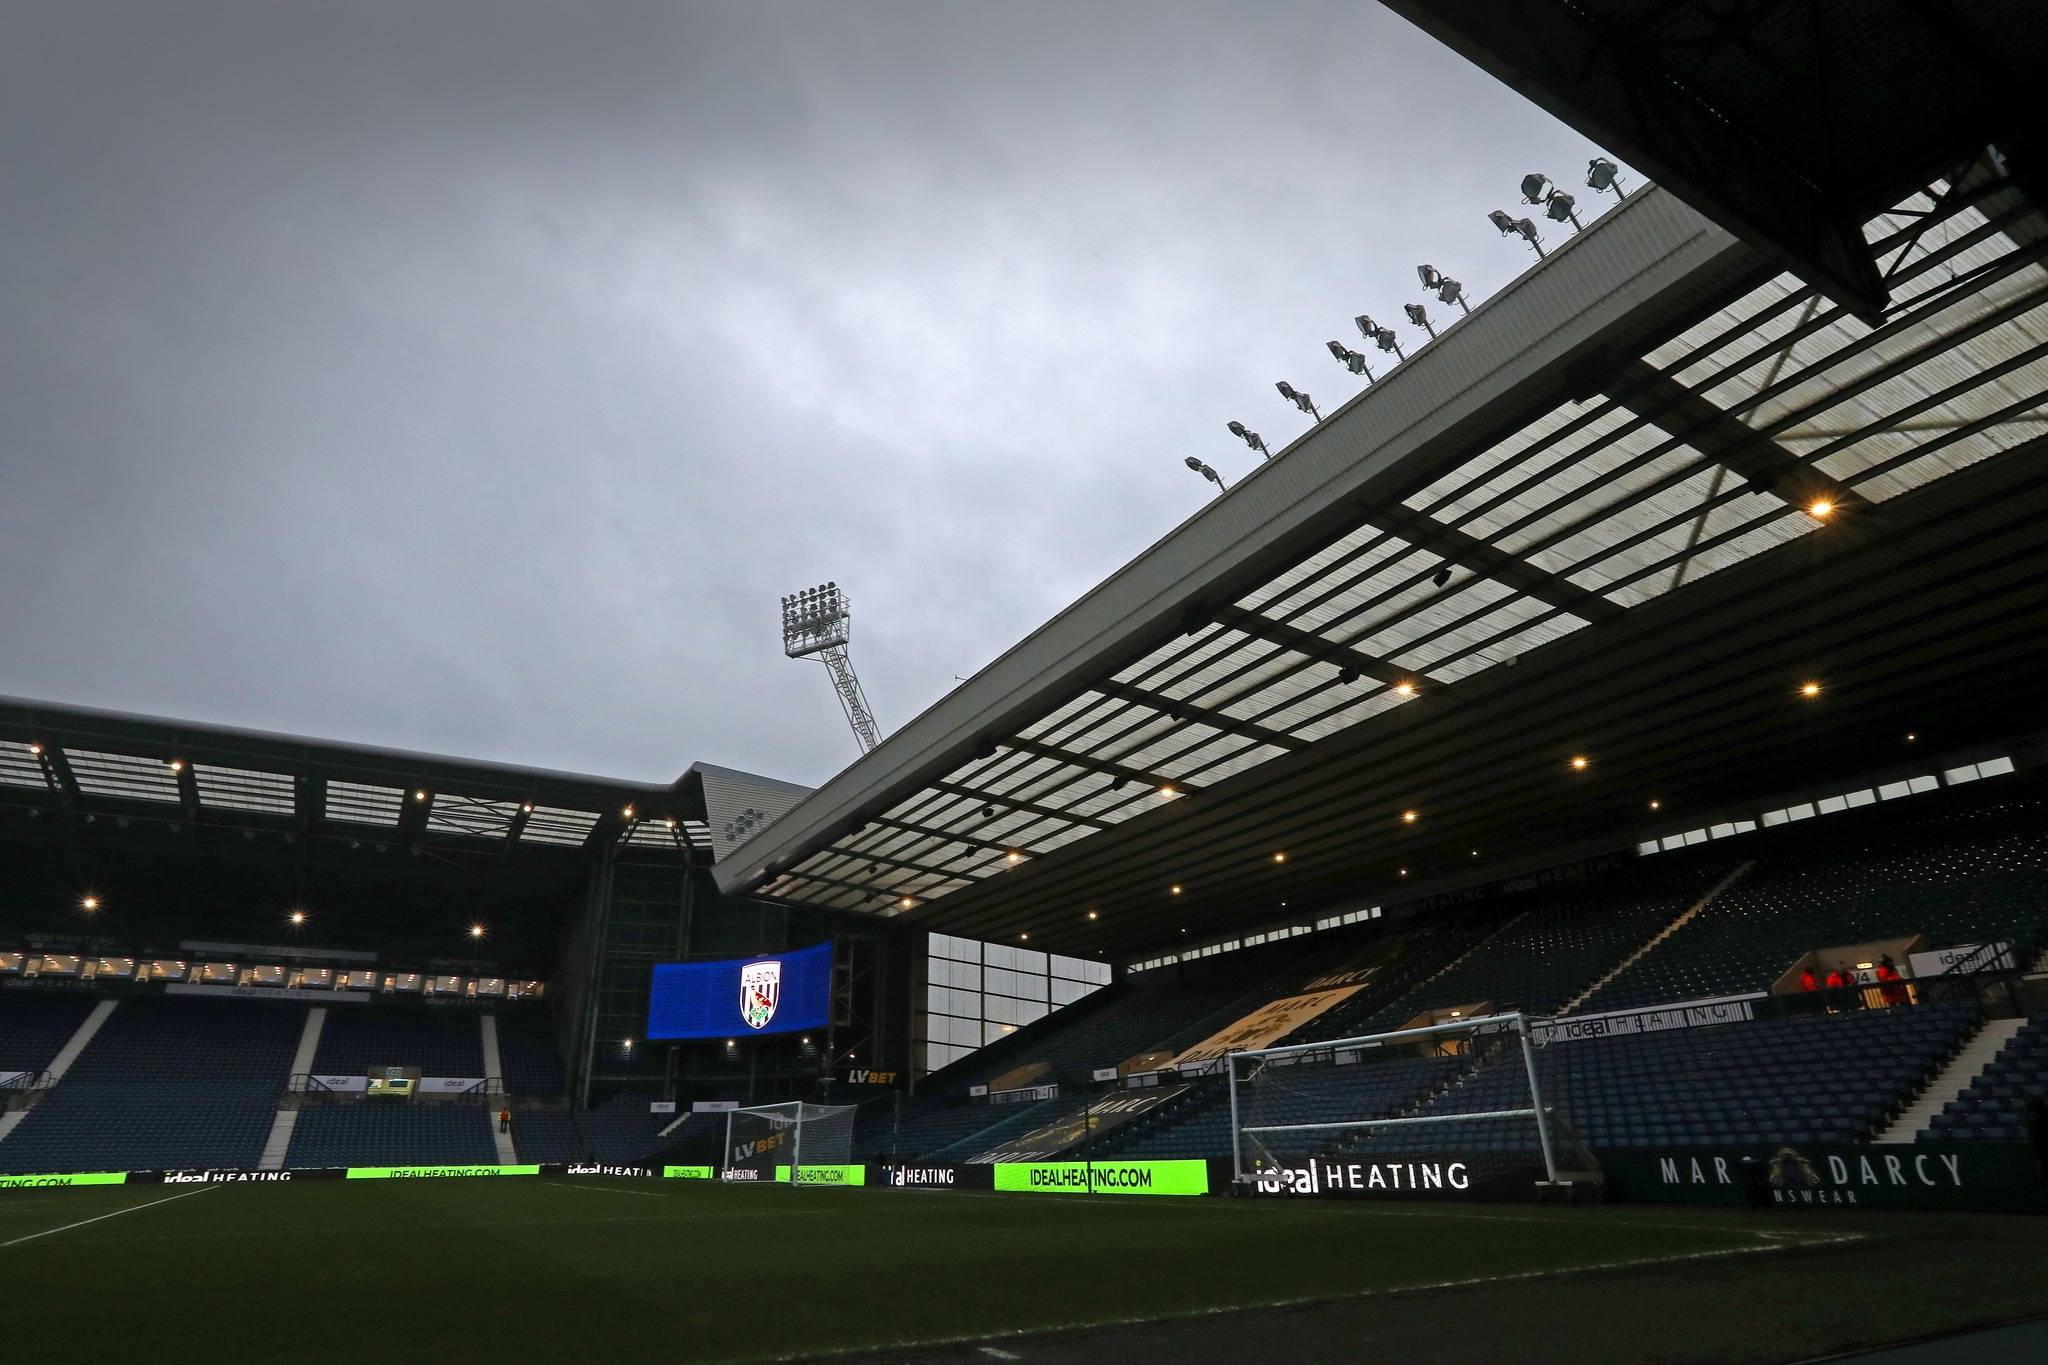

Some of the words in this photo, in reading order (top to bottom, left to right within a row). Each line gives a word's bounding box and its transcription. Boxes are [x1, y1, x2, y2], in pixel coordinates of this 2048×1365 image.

[745, 971, 777, 984] ALBION
[326, 1078, 349, 1086] ideal
[443, 1079, 465, 1088] ideal
[212, 1171, 292, 1182] HEATING
[389, 1168, 501, 1180] IDEALHEATING.COM
[796, 1169, 845, 1183] EALHEATING.COM
[906, 1168, 955, 1185] HEATING
[1326, 1162, 1470, 1190] HEATING
[1660, 1156, 1733, 1185] MAR
[1827, 1154, 1962, 1187] DARCY
[1030, 1168, 1152, 1188] IDEALHEATING.COM
[1772, 1190, 1857, 1204] NSWEAR
